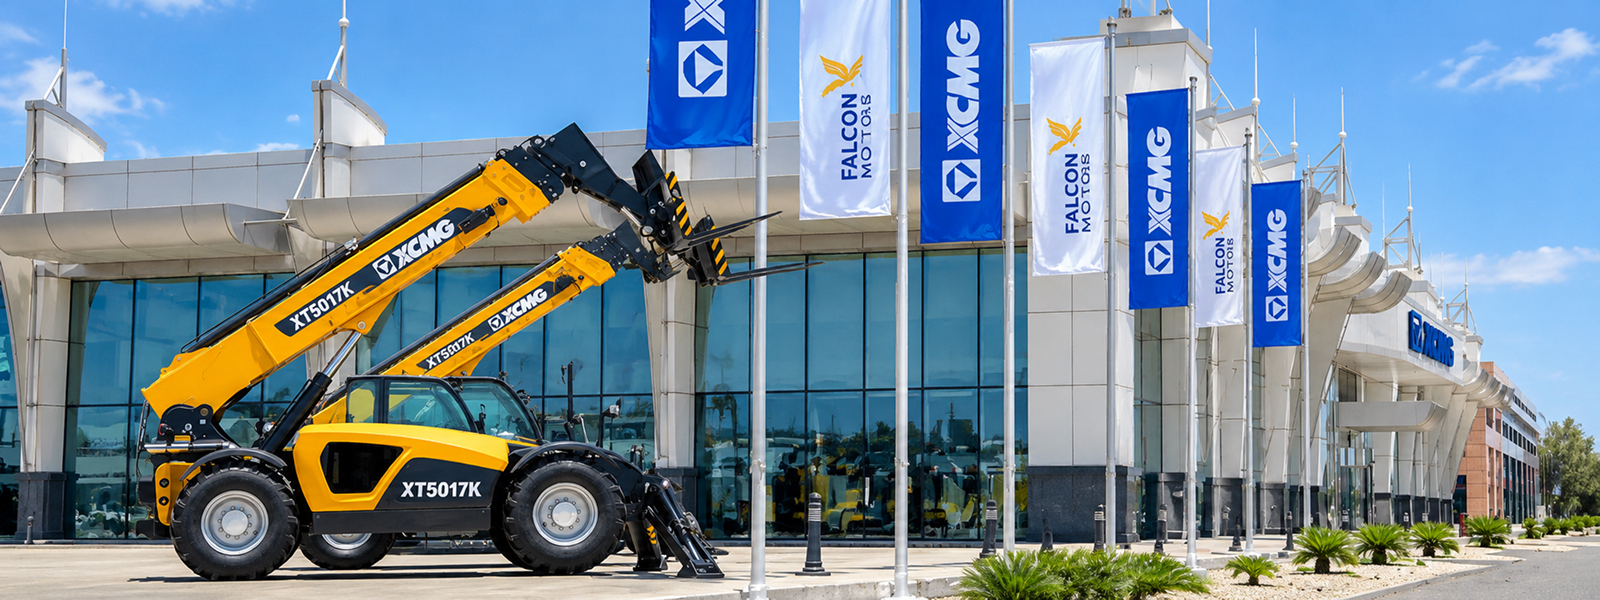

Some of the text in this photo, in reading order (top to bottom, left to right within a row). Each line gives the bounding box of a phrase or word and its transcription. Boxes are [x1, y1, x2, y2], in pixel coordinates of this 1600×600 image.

[946, 19, 980, 154] XCMG
[841, 93, 858, 181] FALCON
[1065, 153, 1079, 234] FALCON
[1146, 126, 1172, 237] XCMG
[391, 218, 455, 270] XCMG
[1215, 237, 1226, 294] FALCON
[1267, 208, 1287, 292] XCMG
[289, 281, 355, 332] XT5017K
[501, 288, 548, 325] XCMG
[1423, 321, 1455, 367] XCMG
[400, 481, 482, 498] XT5017K
